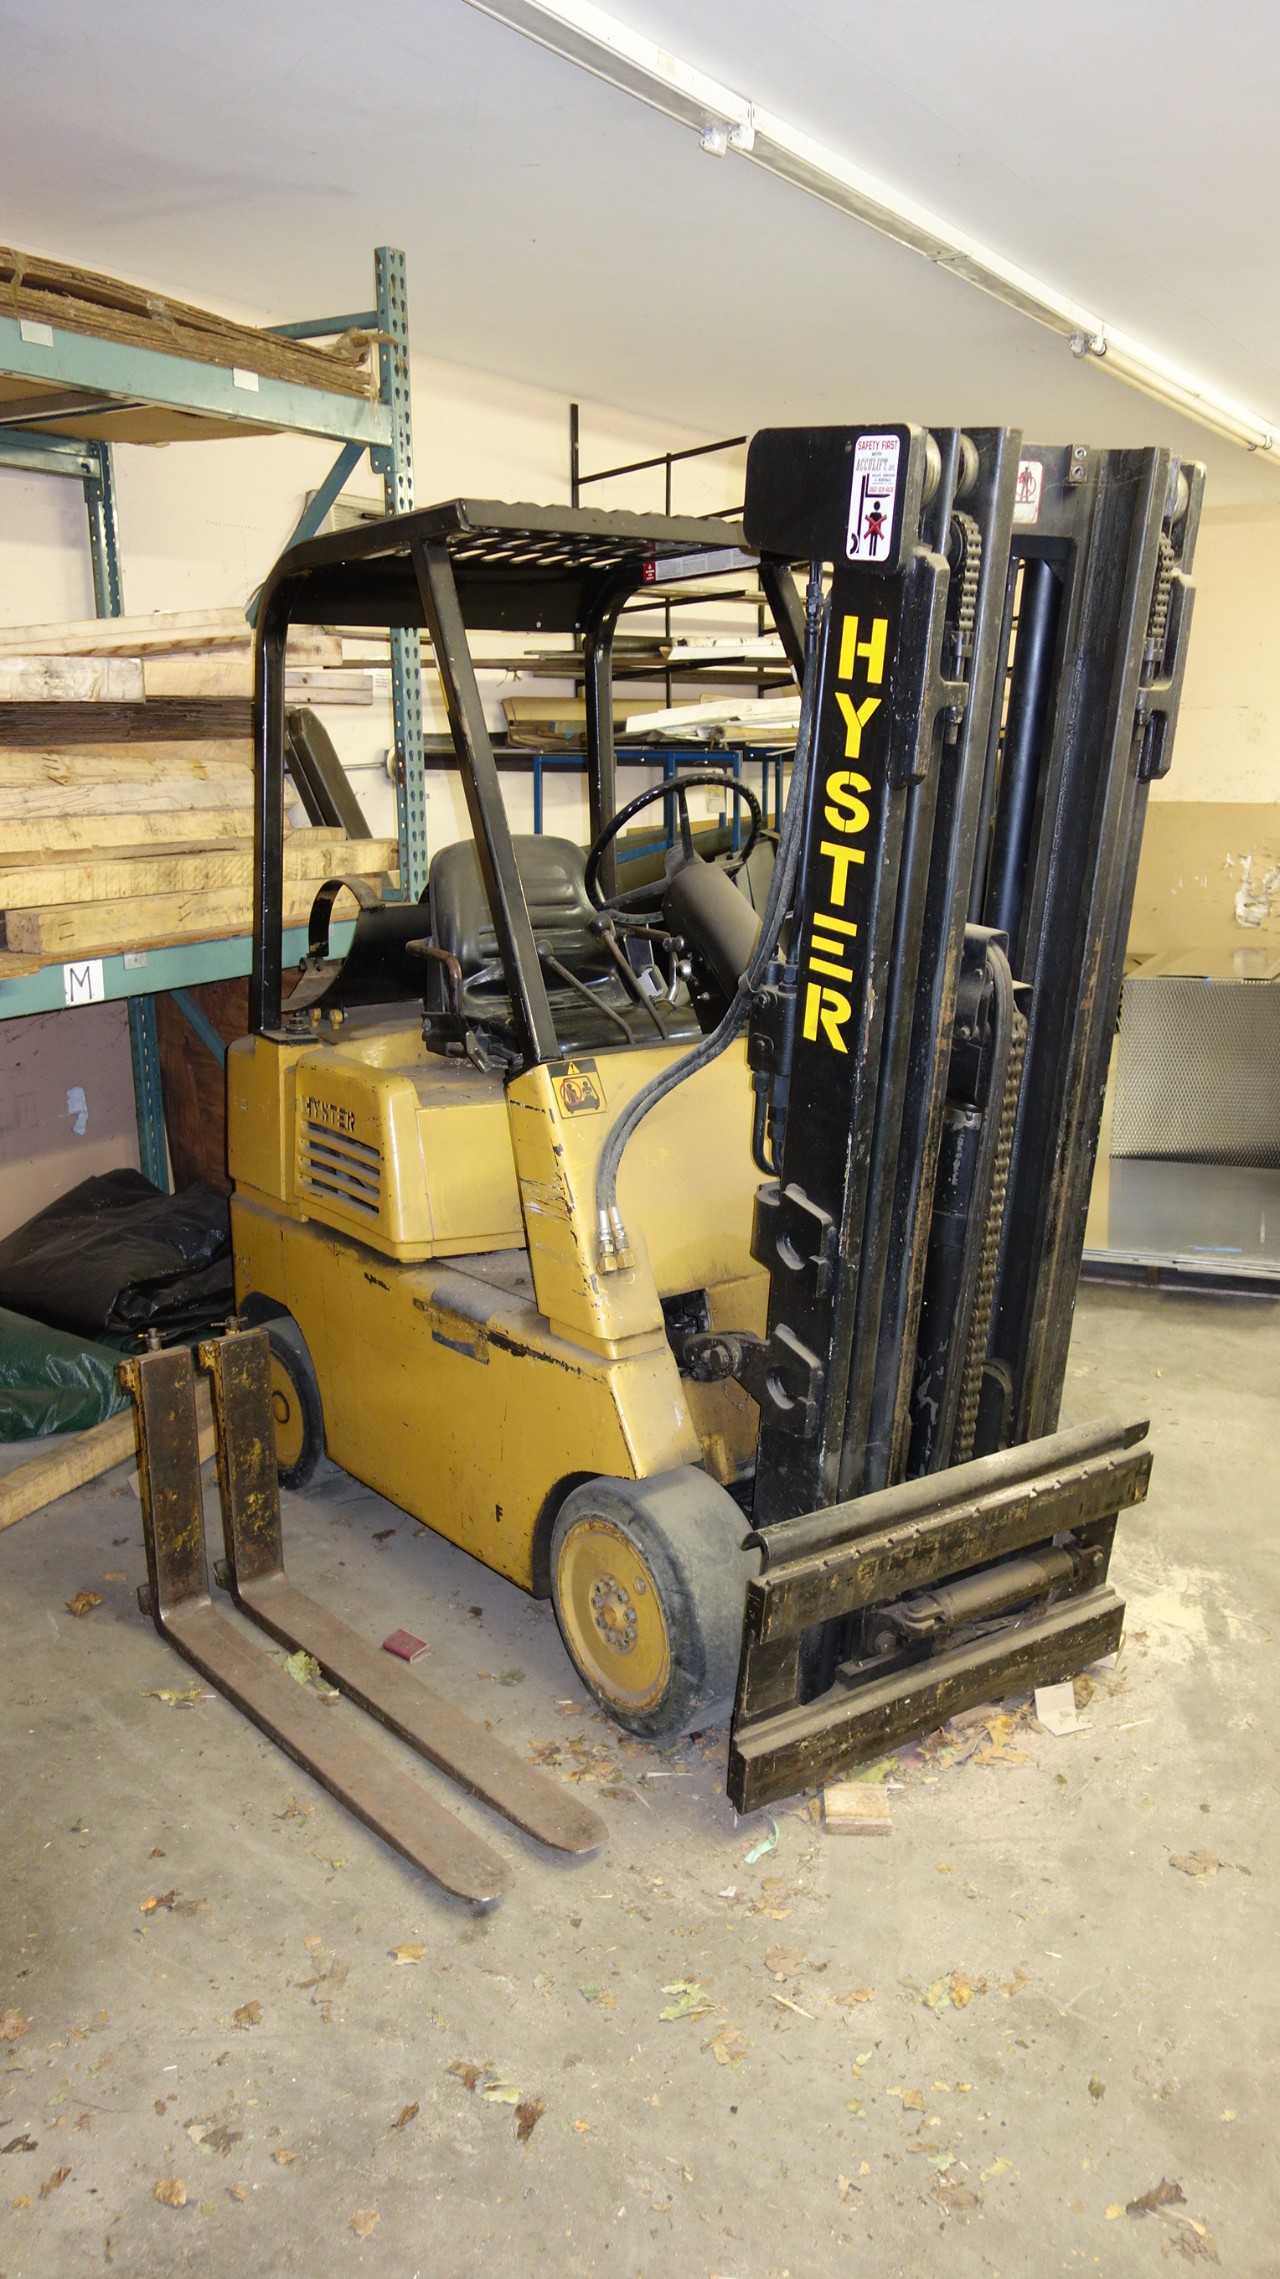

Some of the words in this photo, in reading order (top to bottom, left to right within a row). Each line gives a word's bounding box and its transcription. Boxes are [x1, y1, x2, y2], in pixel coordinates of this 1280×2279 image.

[858, 440, 880, 450] SAFETY
[881, 440, 898, 450] FIRST
[803, 615, 888, 1054] HYSTER
[69, 965, 93, 1002] M
[305, 1096, 355, 1133] HYSTER
